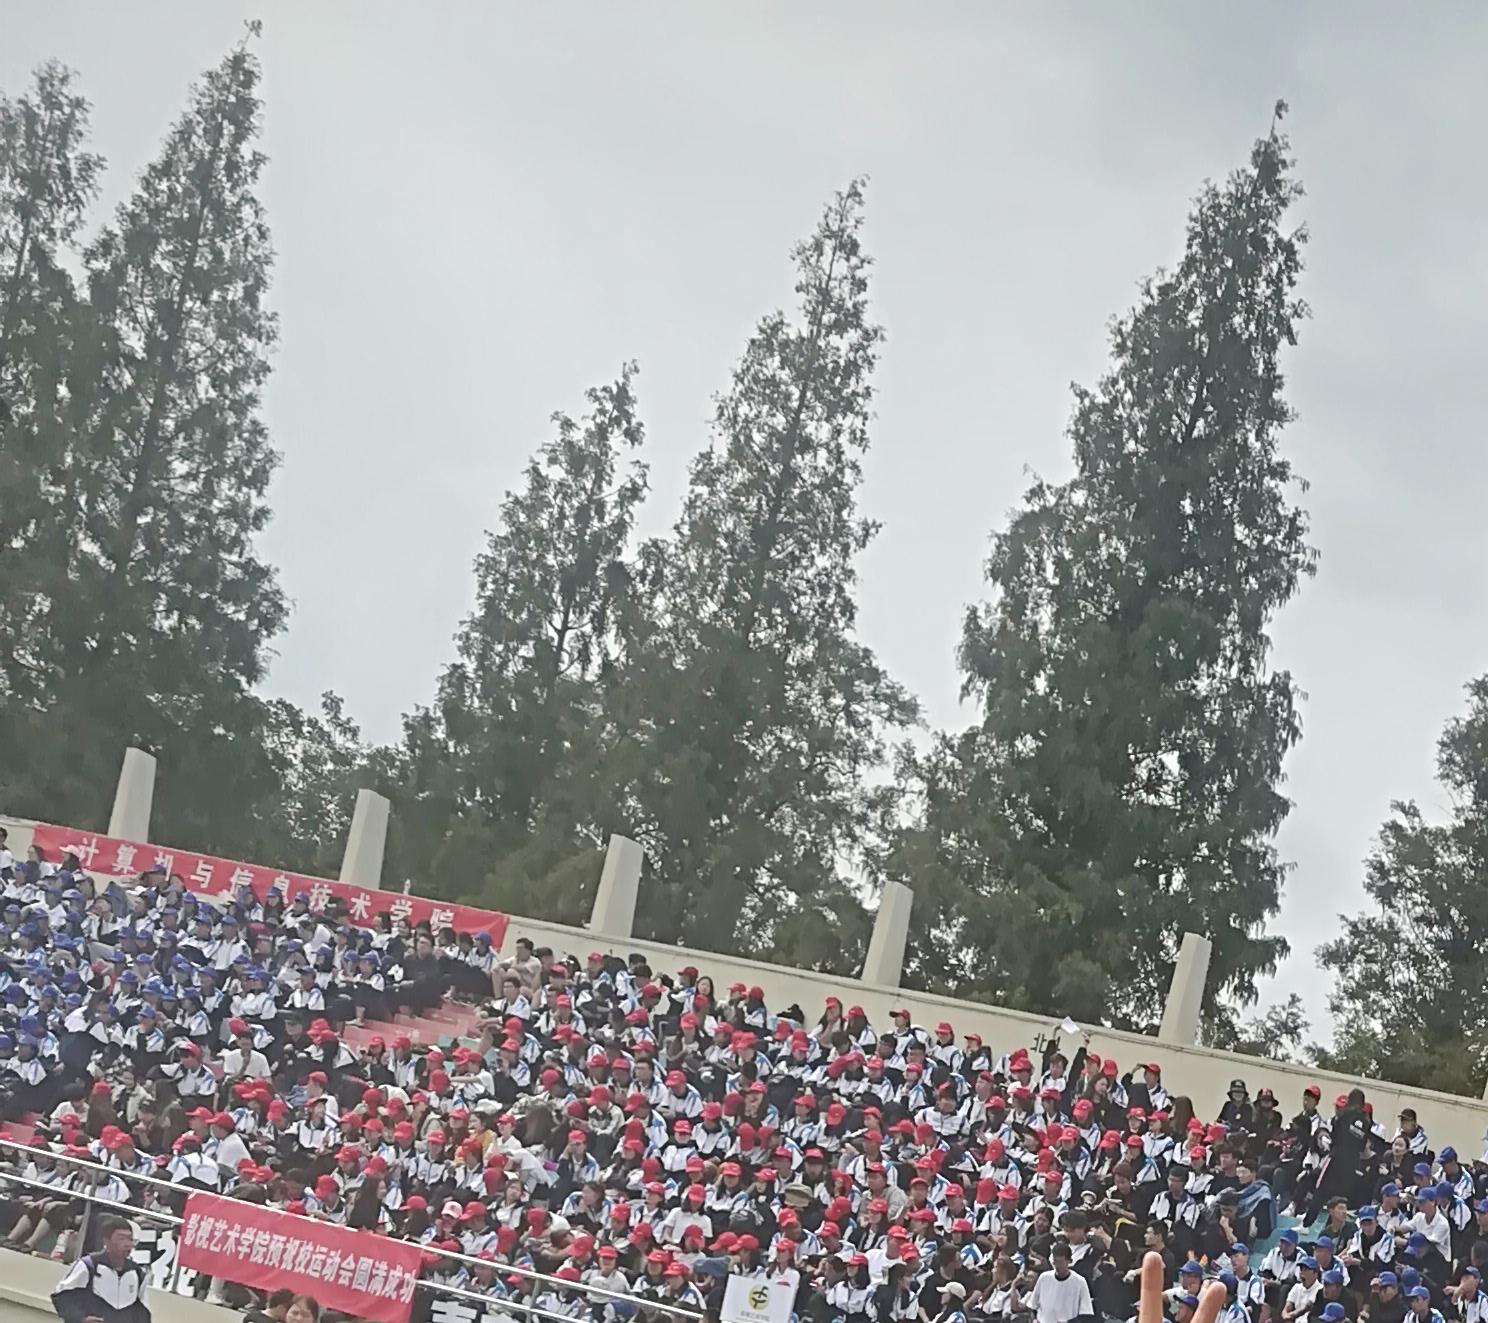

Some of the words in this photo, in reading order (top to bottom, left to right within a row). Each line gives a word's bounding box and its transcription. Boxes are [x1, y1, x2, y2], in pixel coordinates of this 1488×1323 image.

[184, 1213, 416, 1304] 影视艺术学院预祝校运动会圆满成功
